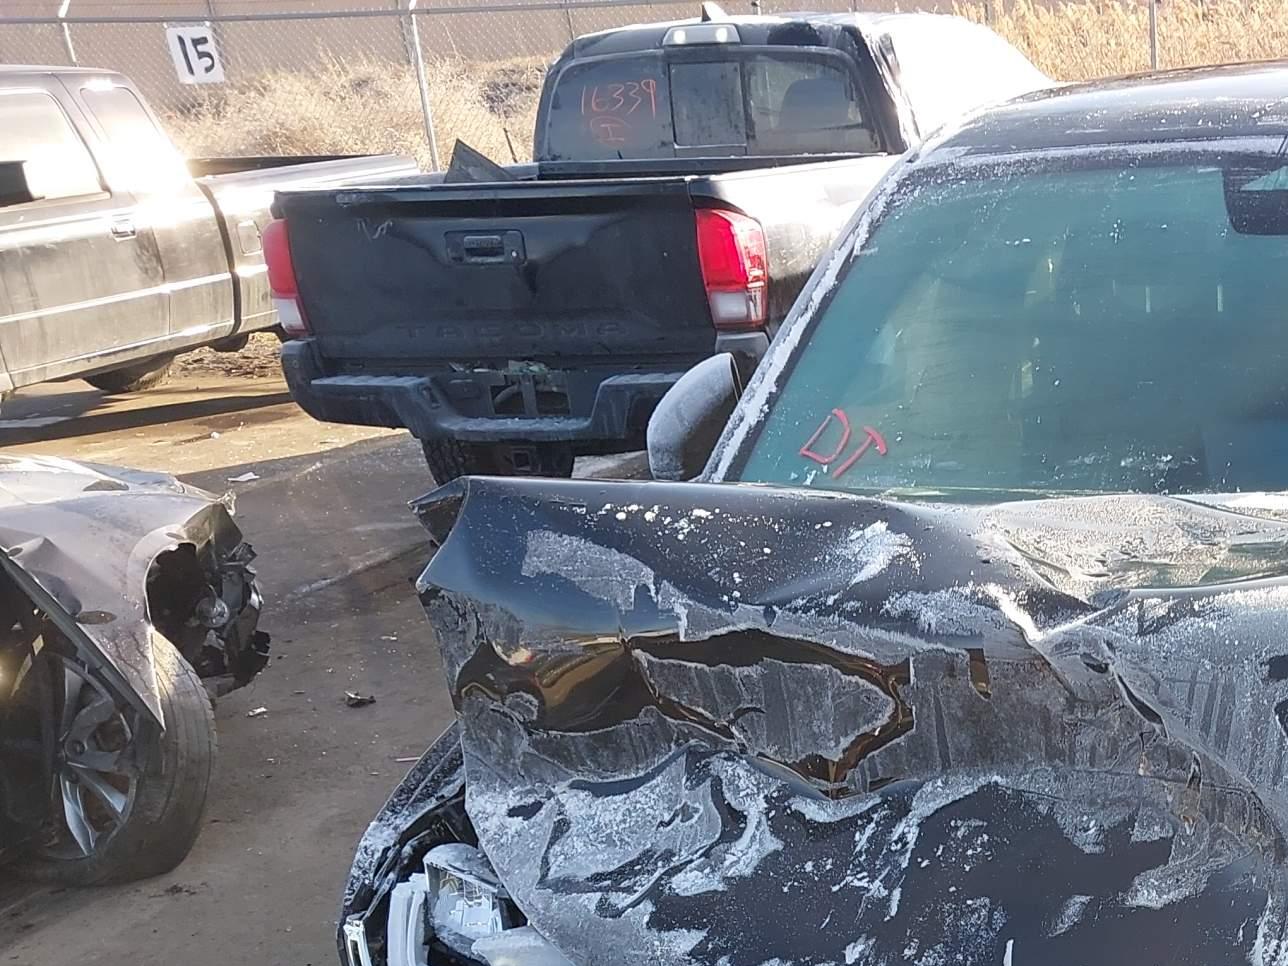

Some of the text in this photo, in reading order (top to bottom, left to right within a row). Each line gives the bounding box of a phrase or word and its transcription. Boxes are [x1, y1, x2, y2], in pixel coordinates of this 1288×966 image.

[177, 34, 215, 76] 15
[580, 79, 657, 120] 16339
[800, 408, 887, 479] DT
